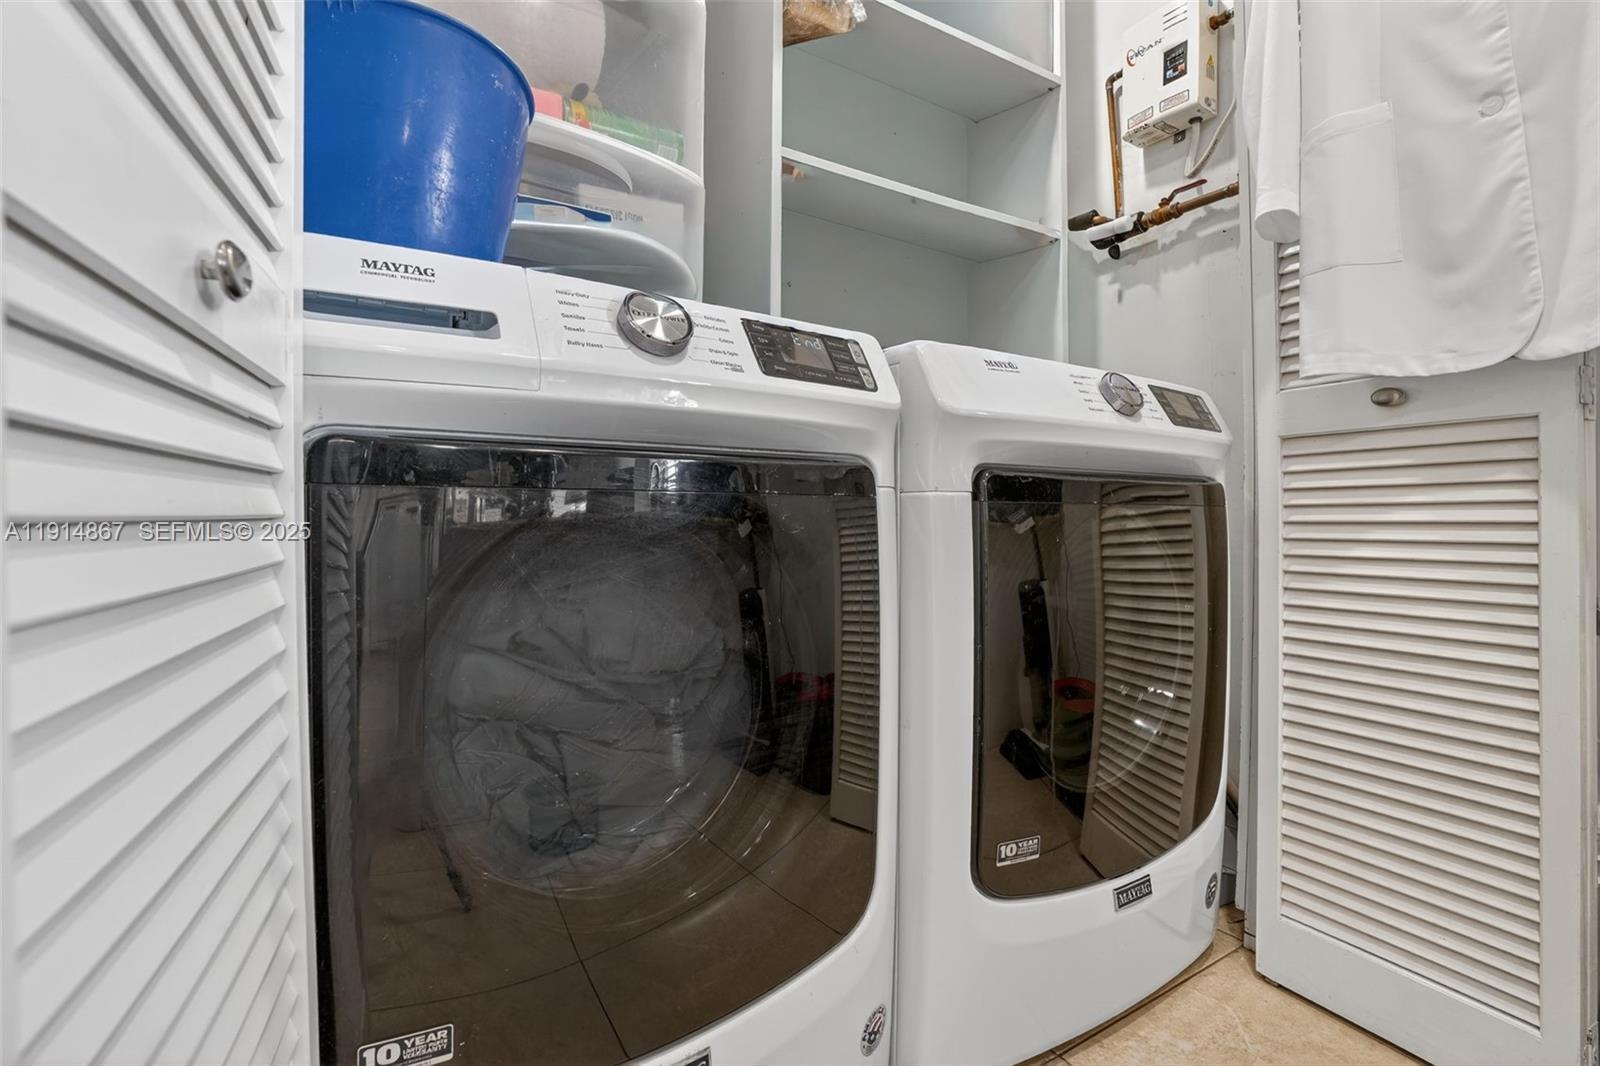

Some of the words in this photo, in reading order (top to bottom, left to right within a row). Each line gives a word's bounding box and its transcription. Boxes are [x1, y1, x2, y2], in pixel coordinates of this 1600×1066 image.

[360, 258, 435, 277] MAYTAG
[1000, 843, 1017, 859] 10
[1119, 882, 1151, 905] MAYTAG
[363, 1042, 401, 1066] 10
[404, 1029, 448, 1048] YEAR
